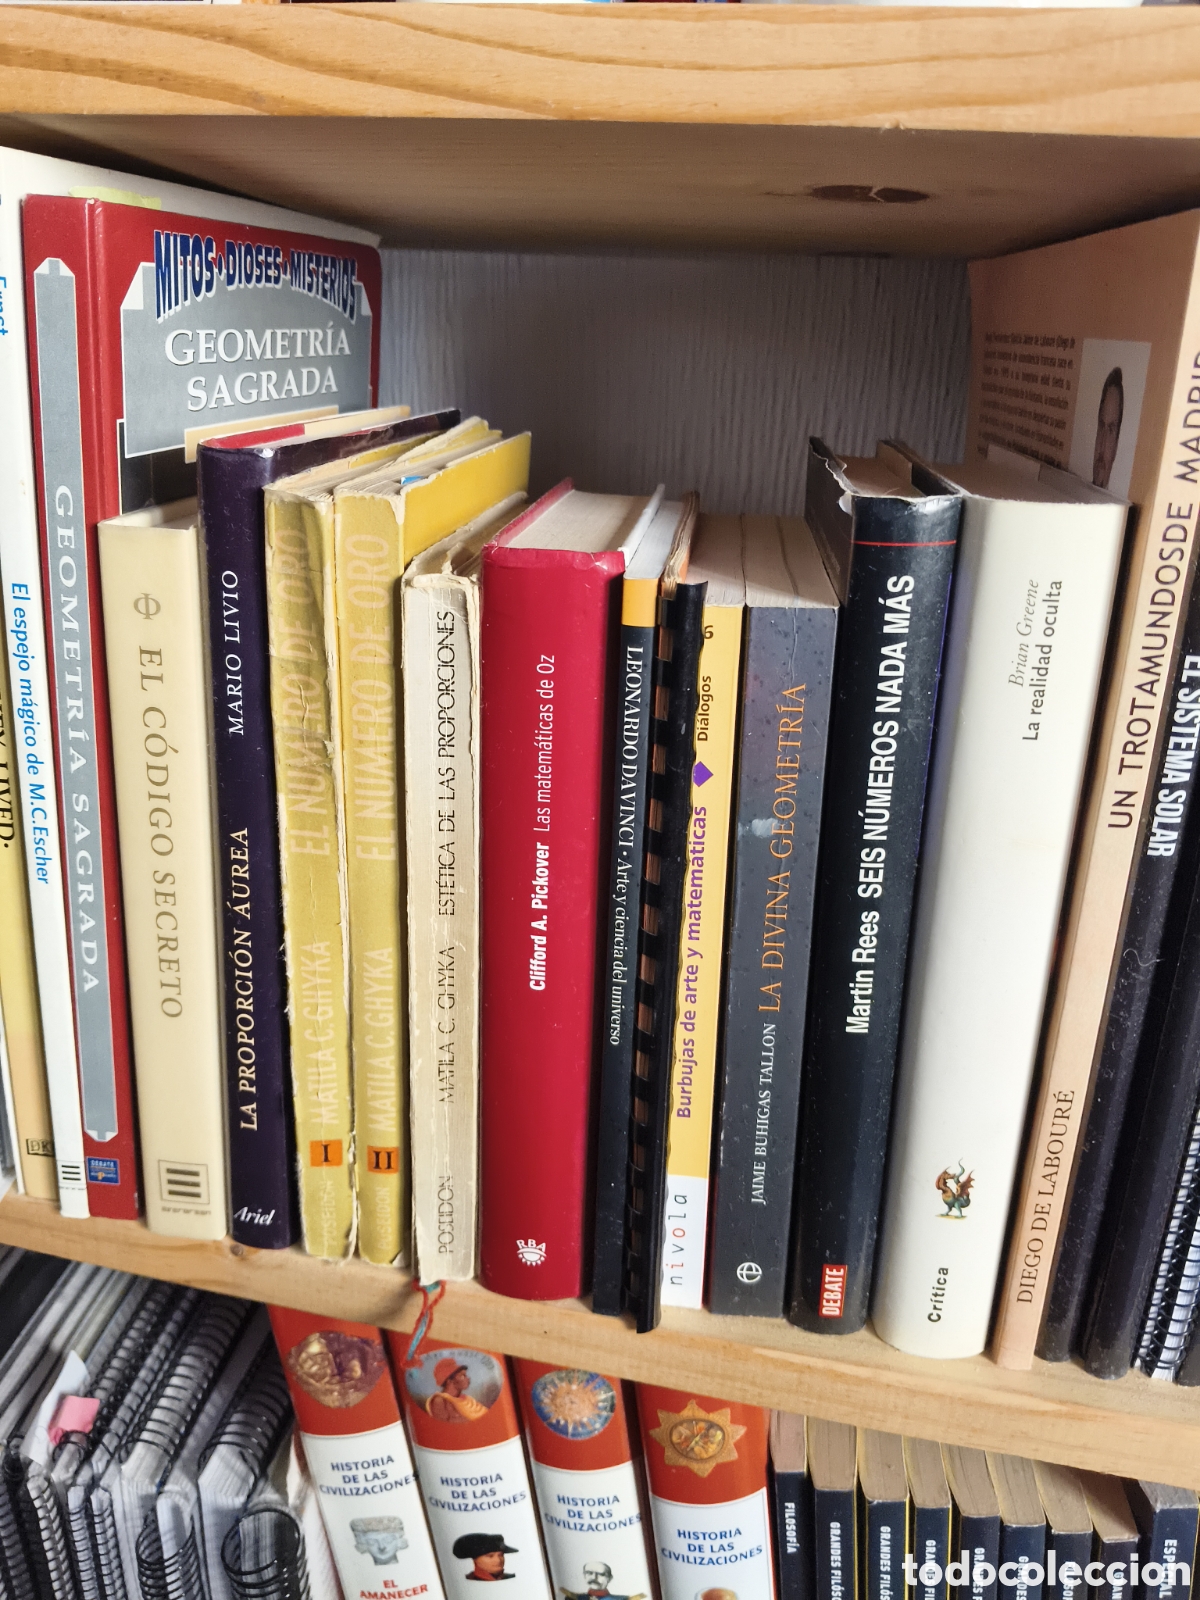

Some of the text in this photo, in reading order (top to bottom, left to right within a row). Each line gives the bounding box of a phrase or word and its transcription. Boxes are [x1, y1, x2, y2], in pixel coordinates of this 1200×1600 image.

[154, 229, 358, 323] MITOS DIOSES MISTERIOS
[165, 321, 351, 366] GEOMETRÍA
[187, 366, 340, 412] SAGRADA
[275, 529, 316, 604] ORO
[11, 582, 29, 601] El
[11, 607, 31, 672] espejo
[221, 570, 244, 736] MARIO LIVIO
[280, 618, 319, 661] DE
[1008, 578, 1040, 689] Brian Greene
[1022, 580, 1063, 741] La realidad oculta
[17, 678, 41, 747] mágico
[346, 534, 397, 861] ORO DE NUMERO EL
[620, 646, 644, 761] LEONARDO
[697, 675, 713, 741] Diálogos
[55, 484, 99, 992] GEOMETRÍA SAGRADA
[435, 610, 456, 915] ESTÉTICA DE LAS PROPORCIONES
[533, 654, 555, 832] Las matemáticas de Oz
[1147, 655, 1200, 857] EL SISTEMA SOLAR
[27, 752, 45, 776] de
[845, 575, 915, 1035] Martin Rees SEIS NÚMEROS NADA MÁS
[1107, 790, 1138, 829] UN
[138, 645, 183, 1018] EL CÓDIGO SECRETO
[290, 825, 330, 855] EL
[758, 683, 807, 1013] LA DIVINA GEOMETRÍA
[529, 842, 549, 991] Clifford A. Pickover
[609, 858, 633, 1046] Arte y ciencia del universo
[687, 947, 703, 960] y
[226, 827, 258, 1132] LA PROPORCIÓN ÁUREA
[363, 947, 394, 1027] GHYKA
[684, 964, 699, 1004] arte
[438, 947, 455, 1103] MATILA C. GHYKA
[680, 1010, 696, 1032] de
[366, 1055, 397, 1132] MATILA
[677, 1037, 698, 1118] Burbujas
[751, 1022, 776, 1206] JAIME BUHIGAS TALLON
[321, 1144, 330, 1162] I
[373, 1150, 394, 1170] II
[233, 1206, 276, 1226] Ariel
[437, 1176, 454, 1254] POSEIDON
[1016, 1089, 1075, 1304] DIEGO DE LABOURÉ
[516, 1239, 546, 1252] RBA
[822, 1266, 845, 1317] DEBATE
[927, 1266, 949, 1323] Crítica
[319, 1472, 419, 1497] CIVILIZACIONES
[330, 1455, 395, 1472] HISTORIA
[342, 1470, 389, 1484] DE LAS
[440, 1473, 503, 1487] HISTORIA
[429, 1491, 527, 1513] CIVILIZACIONES
[451, 1487, 497, 1500] DE LAS
[557, 1494, 620, 1507] HISTORIA
[567, 1509, 613, 1520] DE LAS
[545, 1513, 642, 1532] CIVILIZACIONES
[677, 1528, 742, 1541] HISTORIA
[784, 1502, 800, 1554] FILOSOFÍA
[830, 1521, 841, 1568] GRANDES
[661, 1545, 763, 1566] CIVILIZACIONES
[687, 1542, 735, 1553] DE LAS
[880, 1526, 891, 1572] GRANDES
[360, 1584, 428, 1600] AMANECER
[382, 1579, 399, 1589] EL
